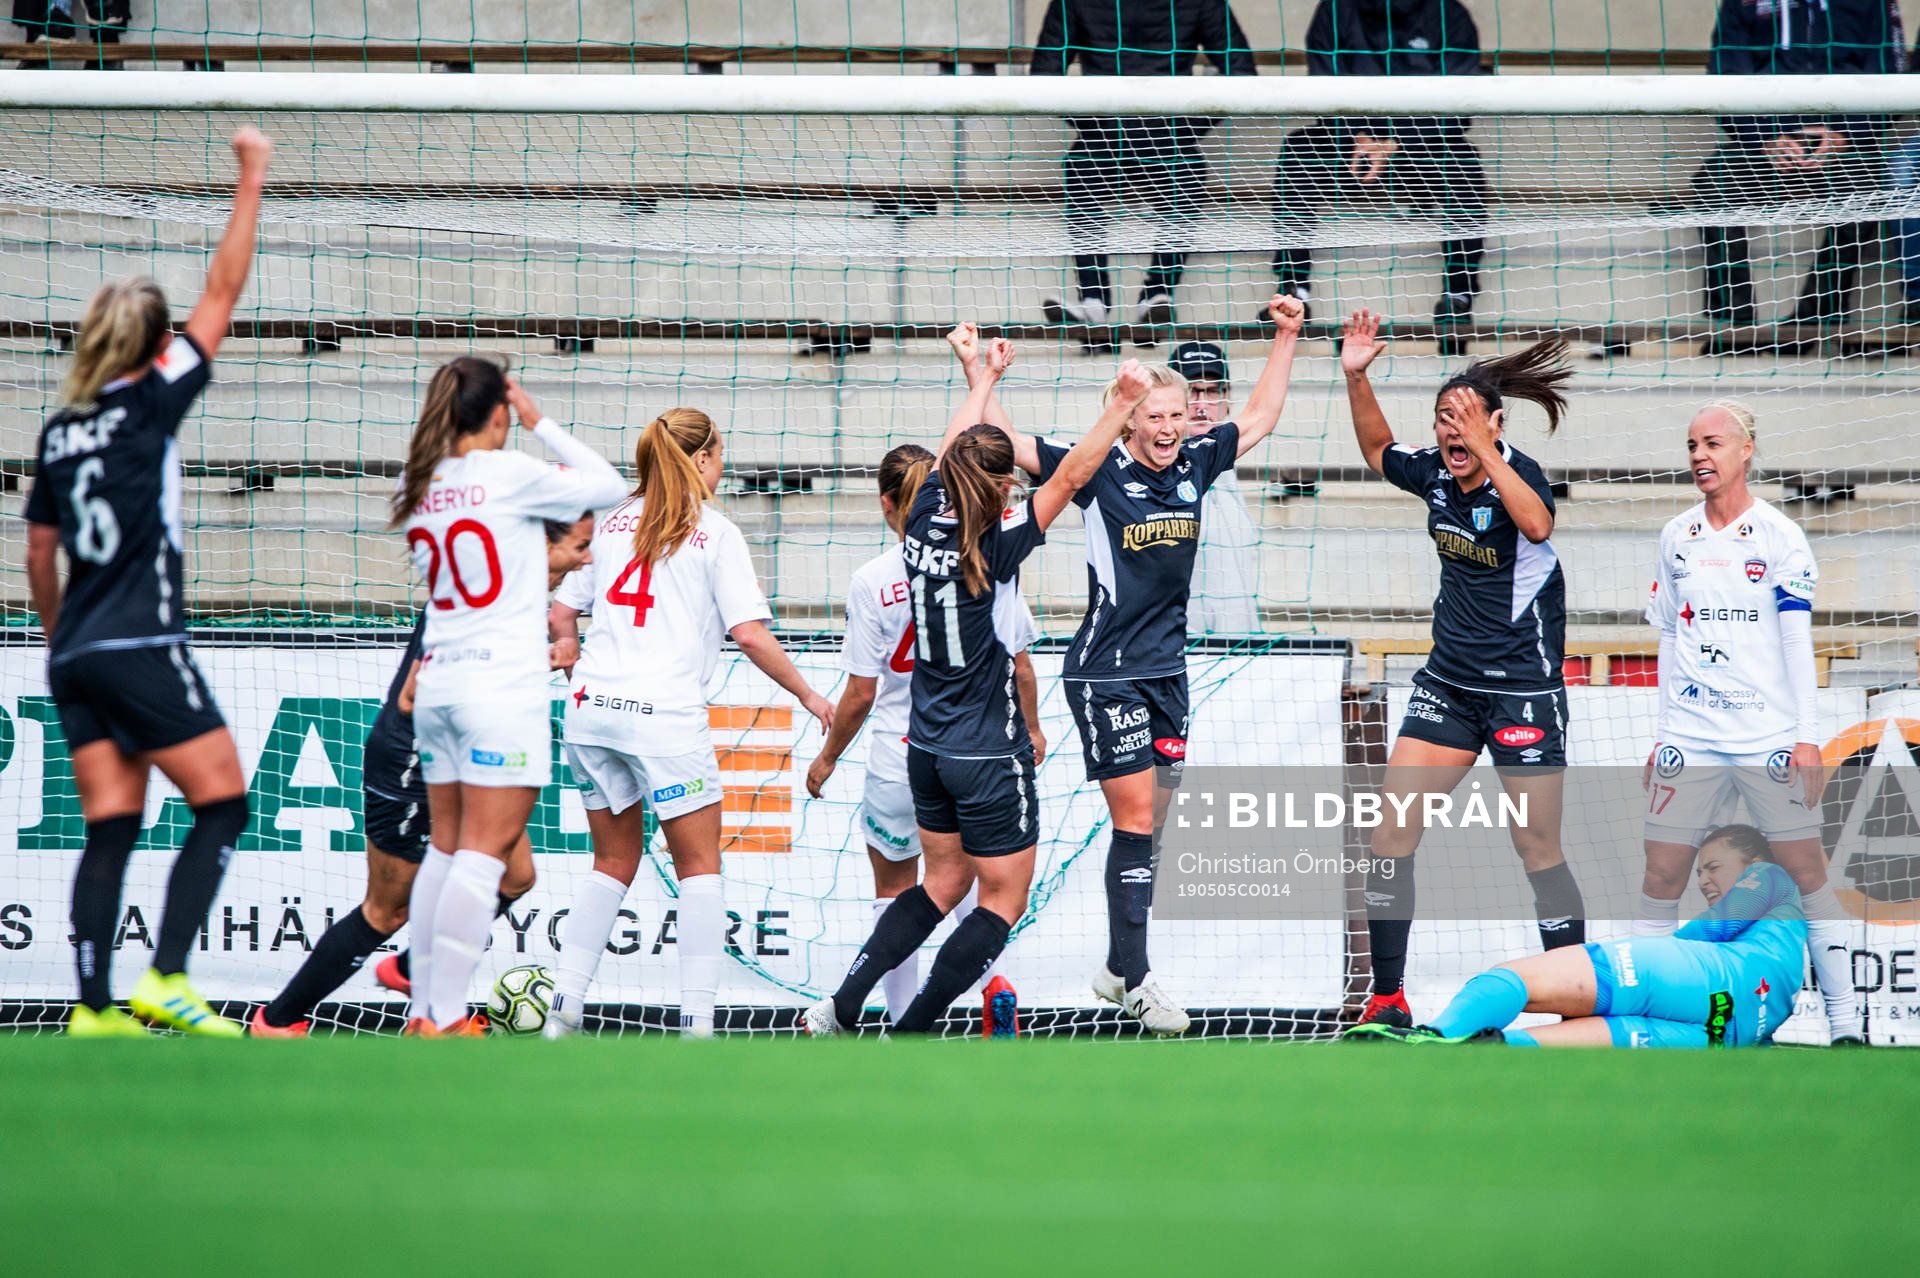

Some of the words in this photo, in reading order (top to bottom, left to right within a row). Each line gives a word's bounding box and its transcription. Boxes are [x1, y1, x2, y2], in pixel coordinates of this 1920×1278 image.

[45, 407, 127, 464] SKF
[70, 456, 121, 566] 6
[407, 518, 503, 611] 20
[903, 534, 960, 577] SKF
[606, 550, 655, 627] 4
[910, 573, 966, 667] 11
[1522, 701, 1534, 722] 4
[657, 785, 683, 801] MKB
[1650, 783, 1676, 815] 17
[849, 952, 870, 976] umbro
